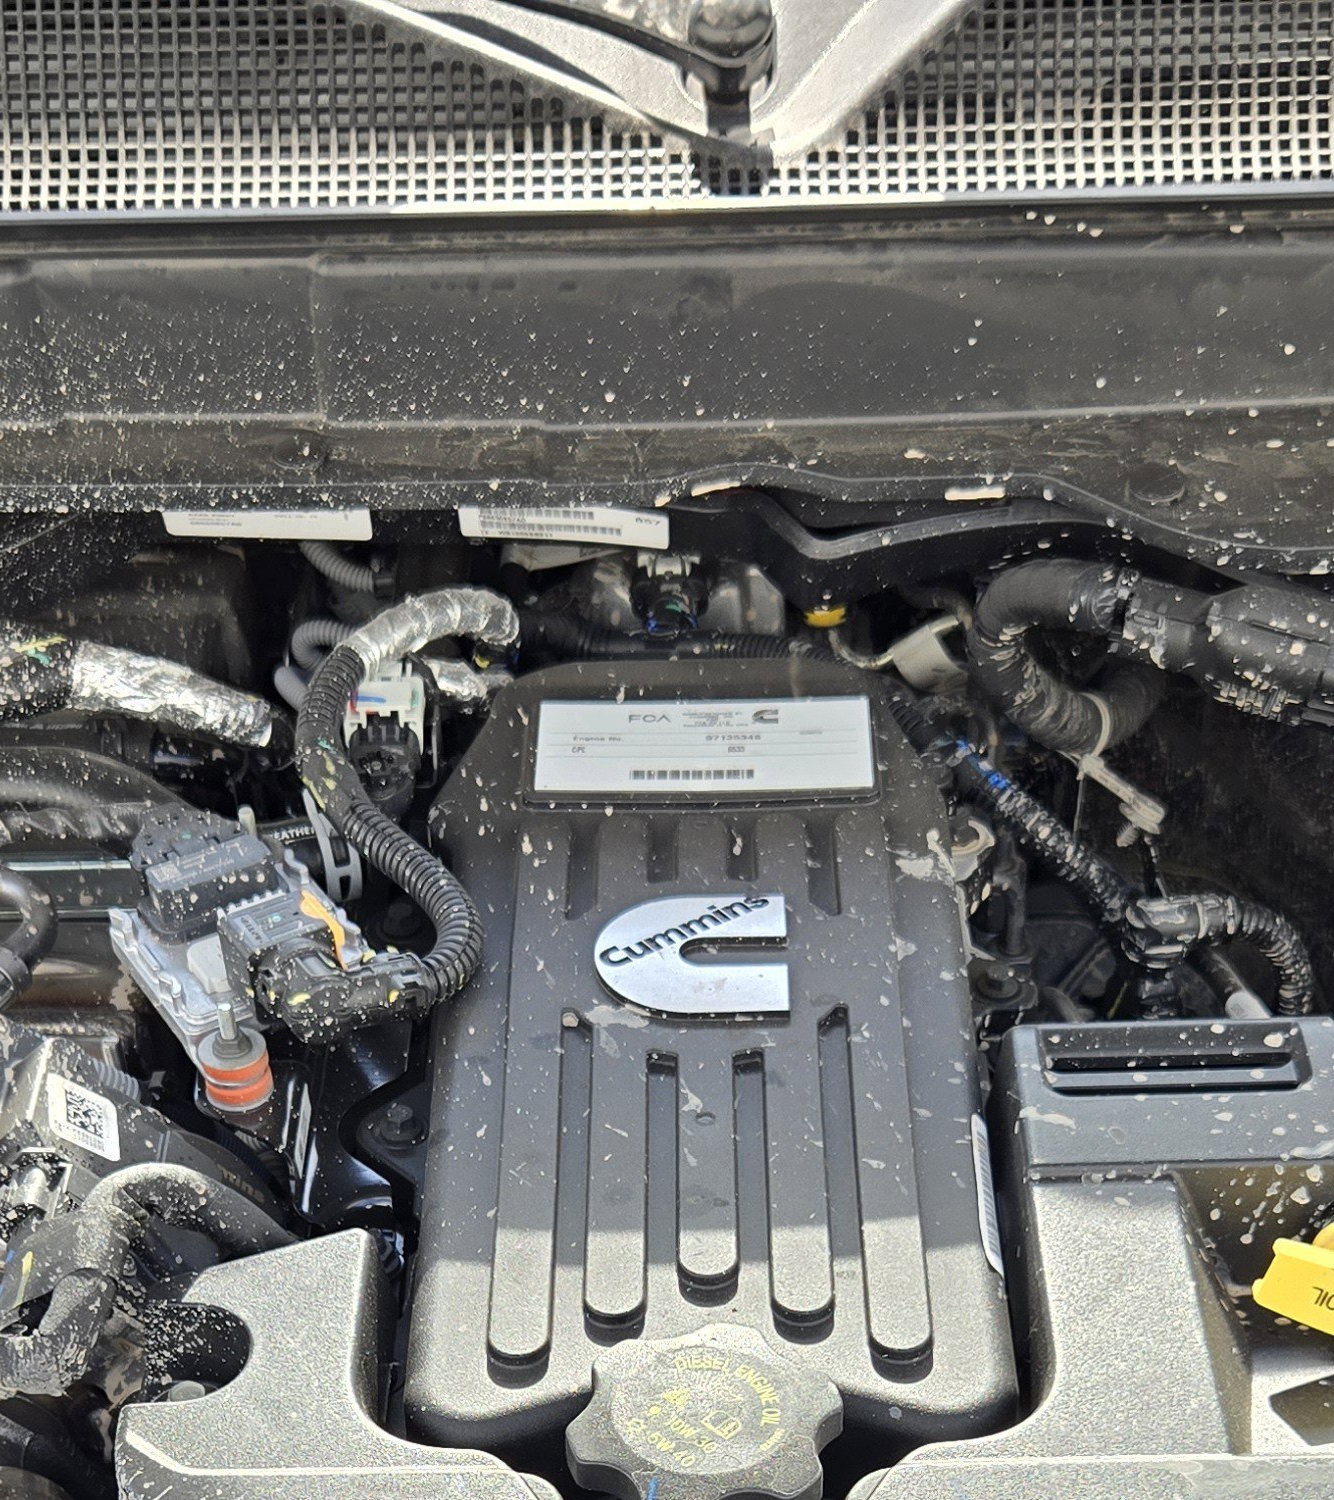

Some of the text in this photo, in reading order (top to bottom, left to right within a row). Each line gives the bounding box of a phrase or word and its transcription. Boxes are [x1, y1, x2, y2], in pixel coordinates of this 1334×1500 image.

[628, 714, 672, 724] FCA
[599, 896, 770, 967] Cummins
[672, 1355, 782, 1427] DIESEL ENGINE OIL
